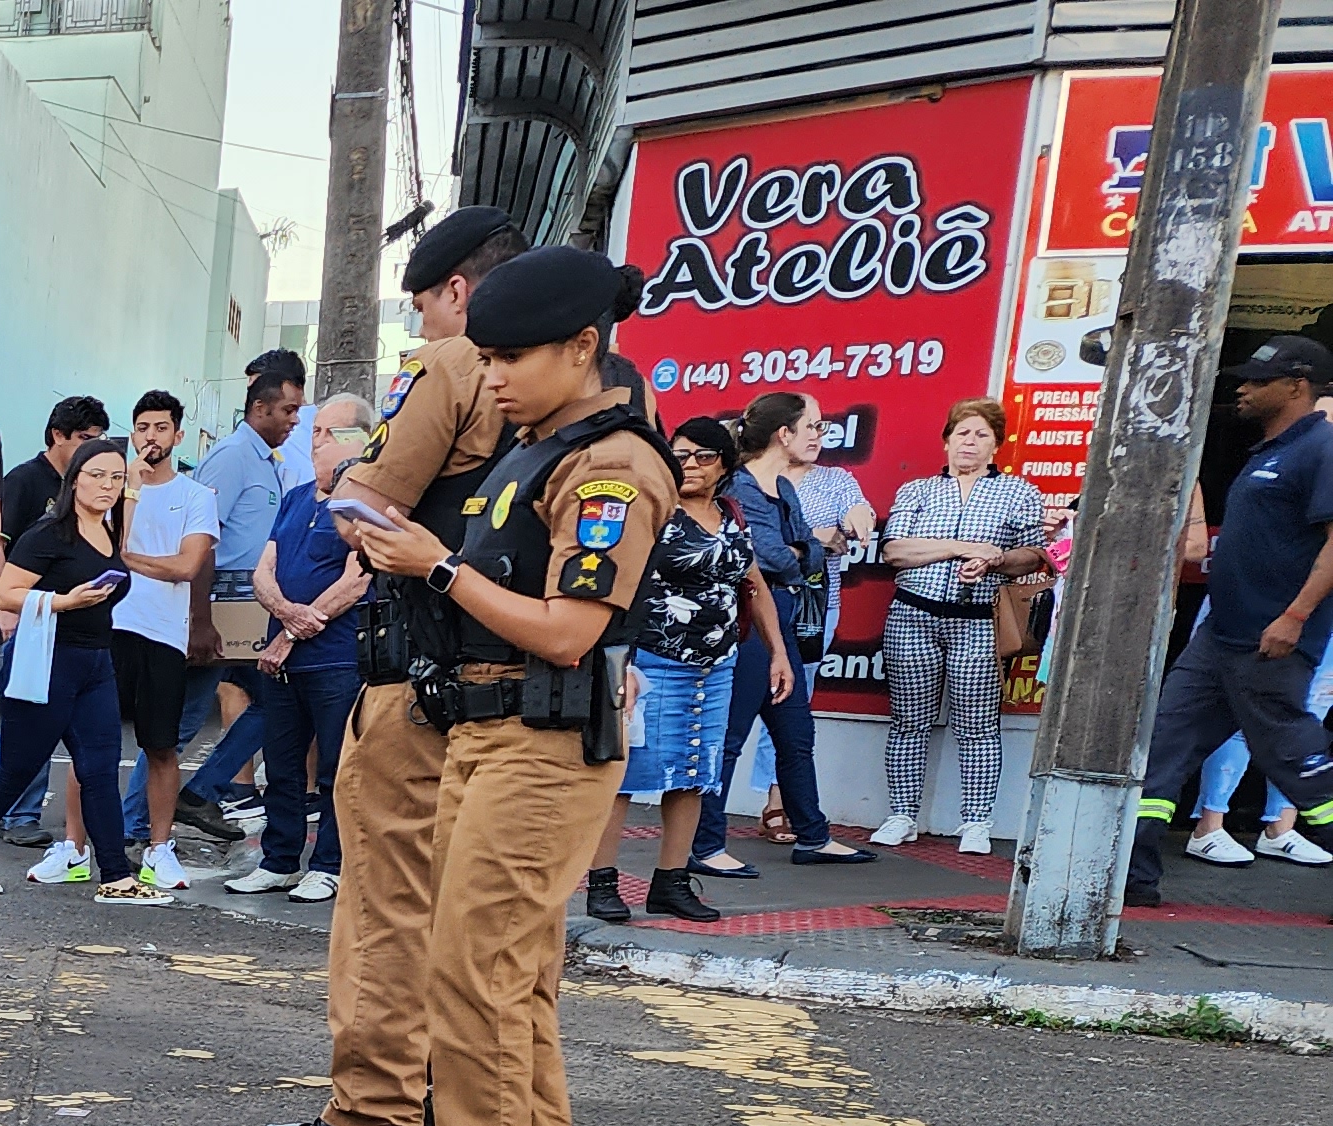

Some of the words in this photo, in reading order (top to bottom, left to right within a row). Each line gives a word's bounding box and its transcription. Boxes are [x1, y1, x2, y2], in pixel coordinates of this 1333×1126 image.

[677, 155, 921, 237] Vera
[638, 203, 990, 316] Ateliê
[681, 362, 730, 392] (44)
[740, 339, 944, 385] 3034-7319
[1032, 390, 1080, 405] PREGA
[1025, 430, 1084, 446] AJUSTE
[1021, 461, 1073, 477] FUROS
